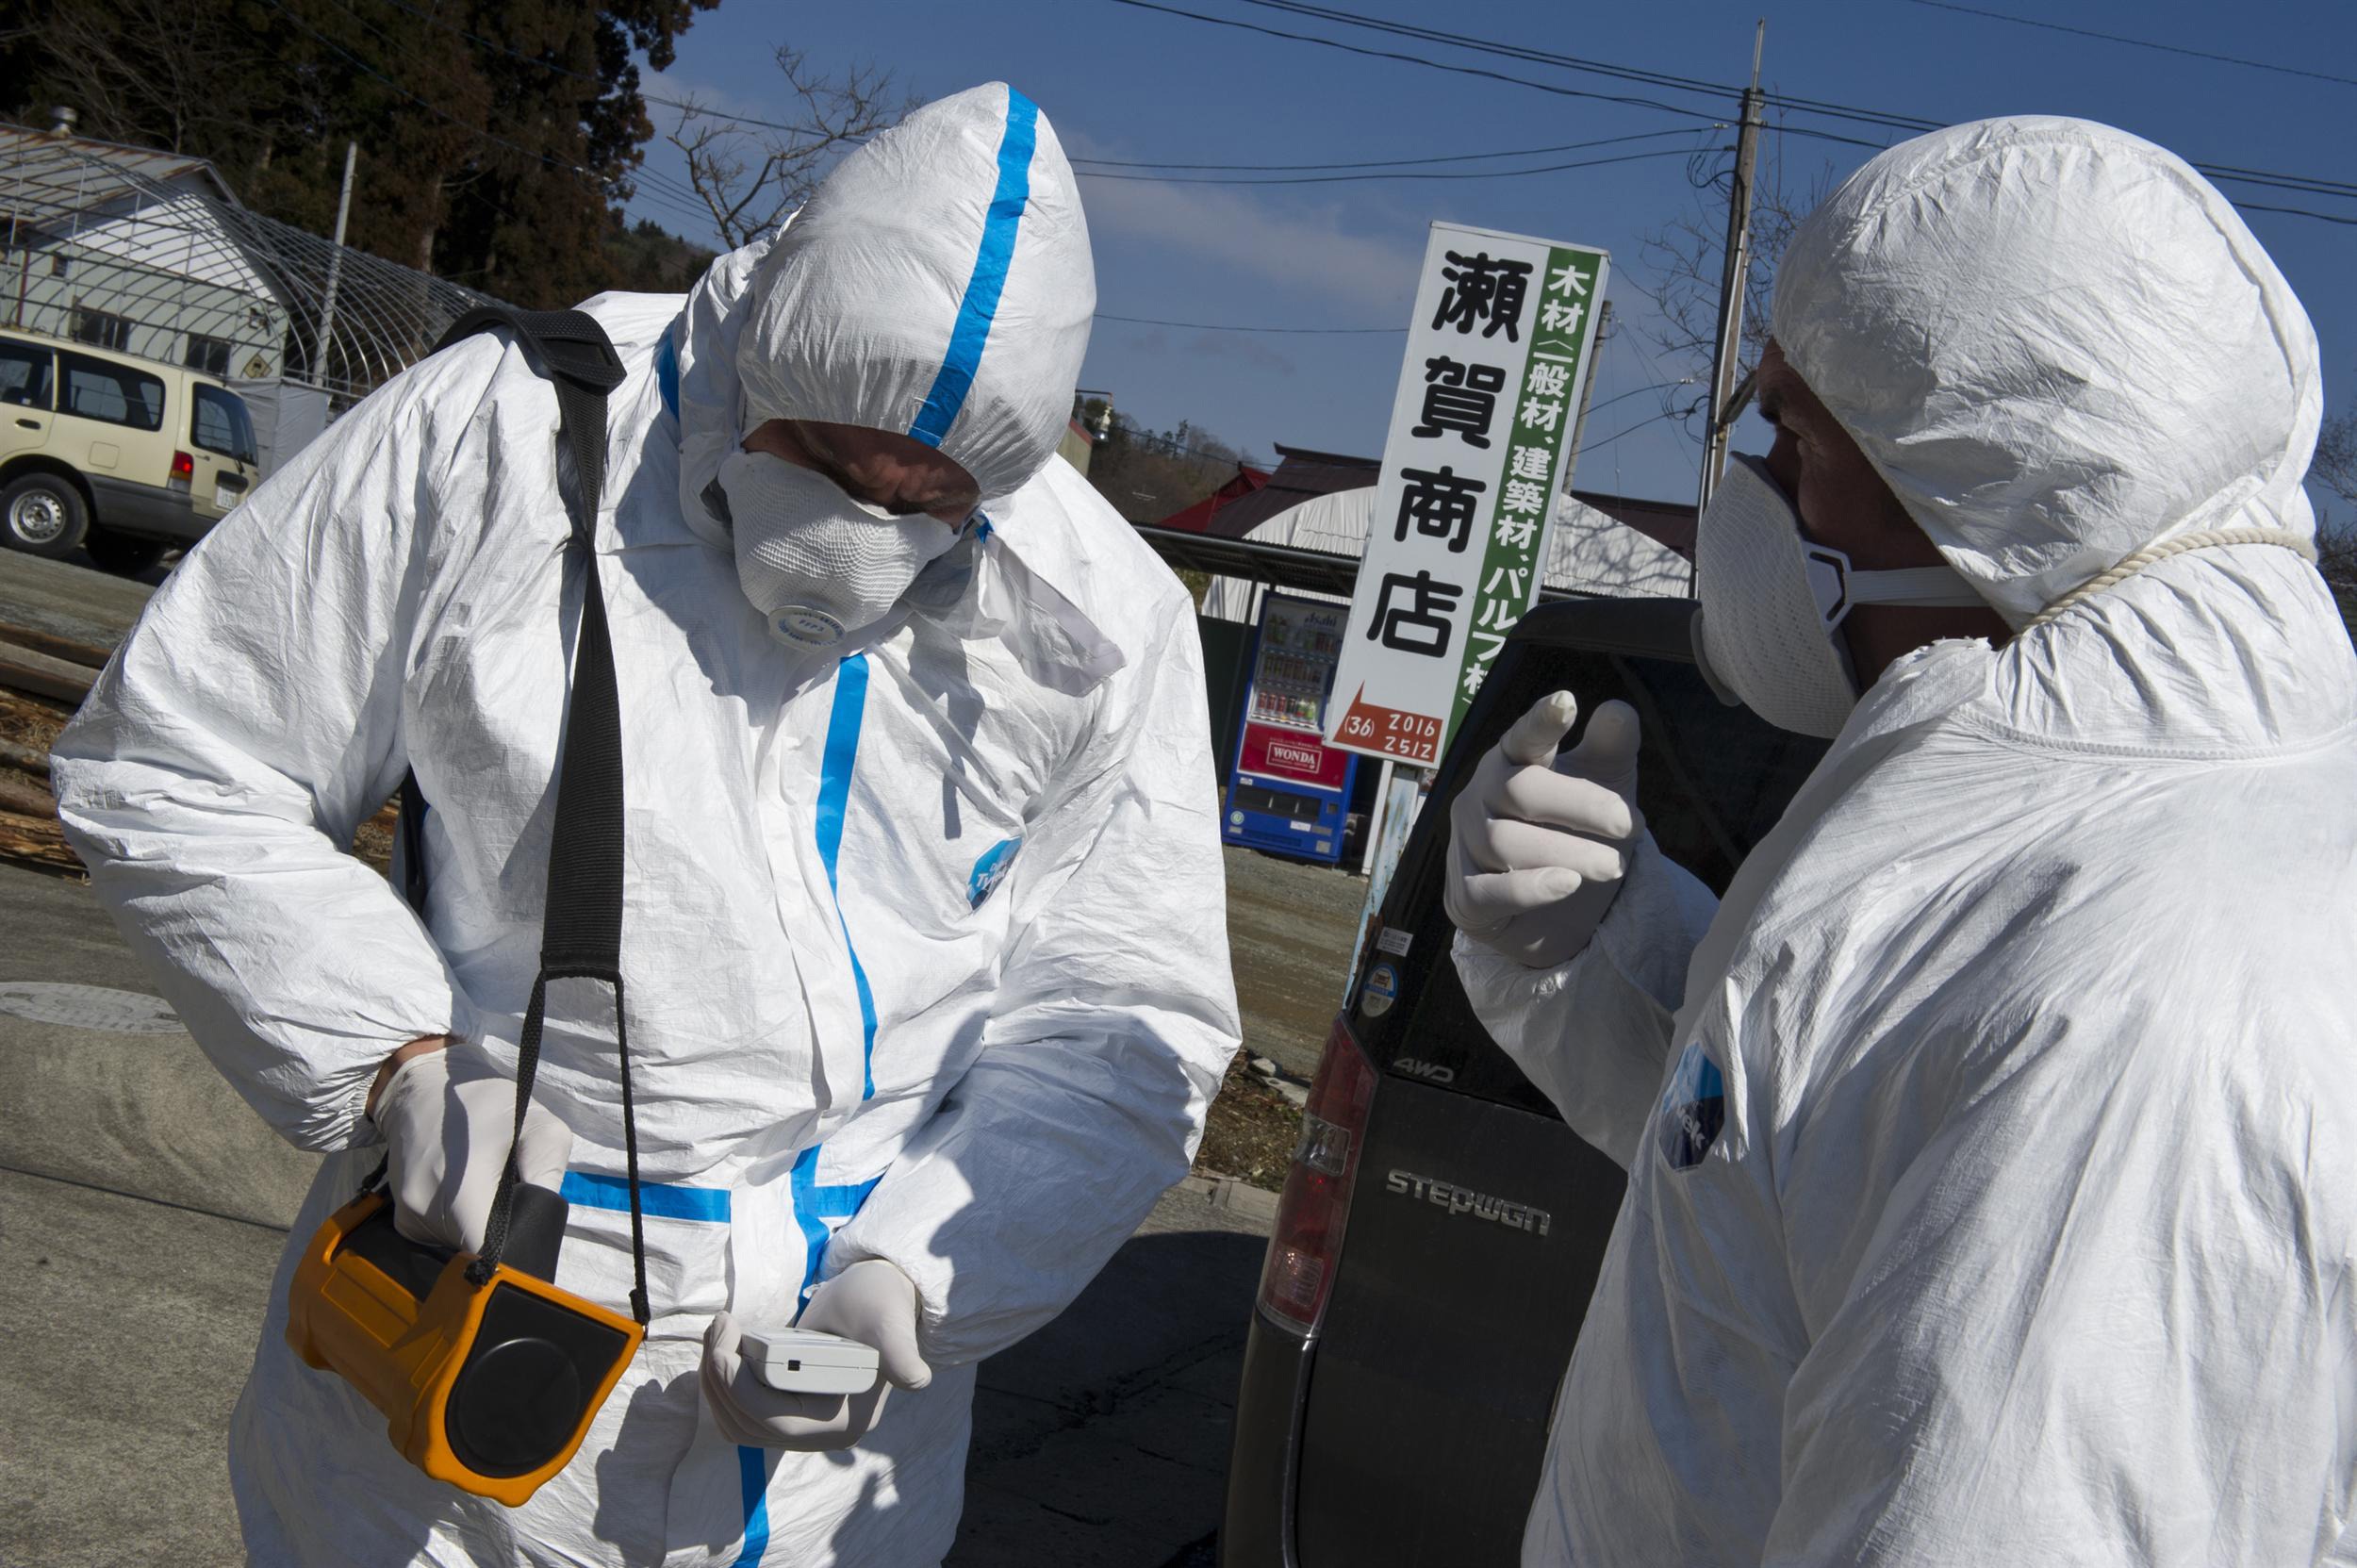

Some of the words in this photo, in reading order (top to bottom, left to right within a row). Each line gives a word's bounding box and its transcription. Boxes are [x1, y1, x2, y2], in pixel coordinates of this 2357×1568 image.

[1366, 250, 1534, 659] 瀬賀商店
[1343, 715, 1375, 738] (36)
[1388, 713, 1435, 737] 2016
[1273, 747, 1316, 765] WONDA
[1383, 735, 1433, 759] 2512
[1393, 1057, 1455, 1082] 4WD
